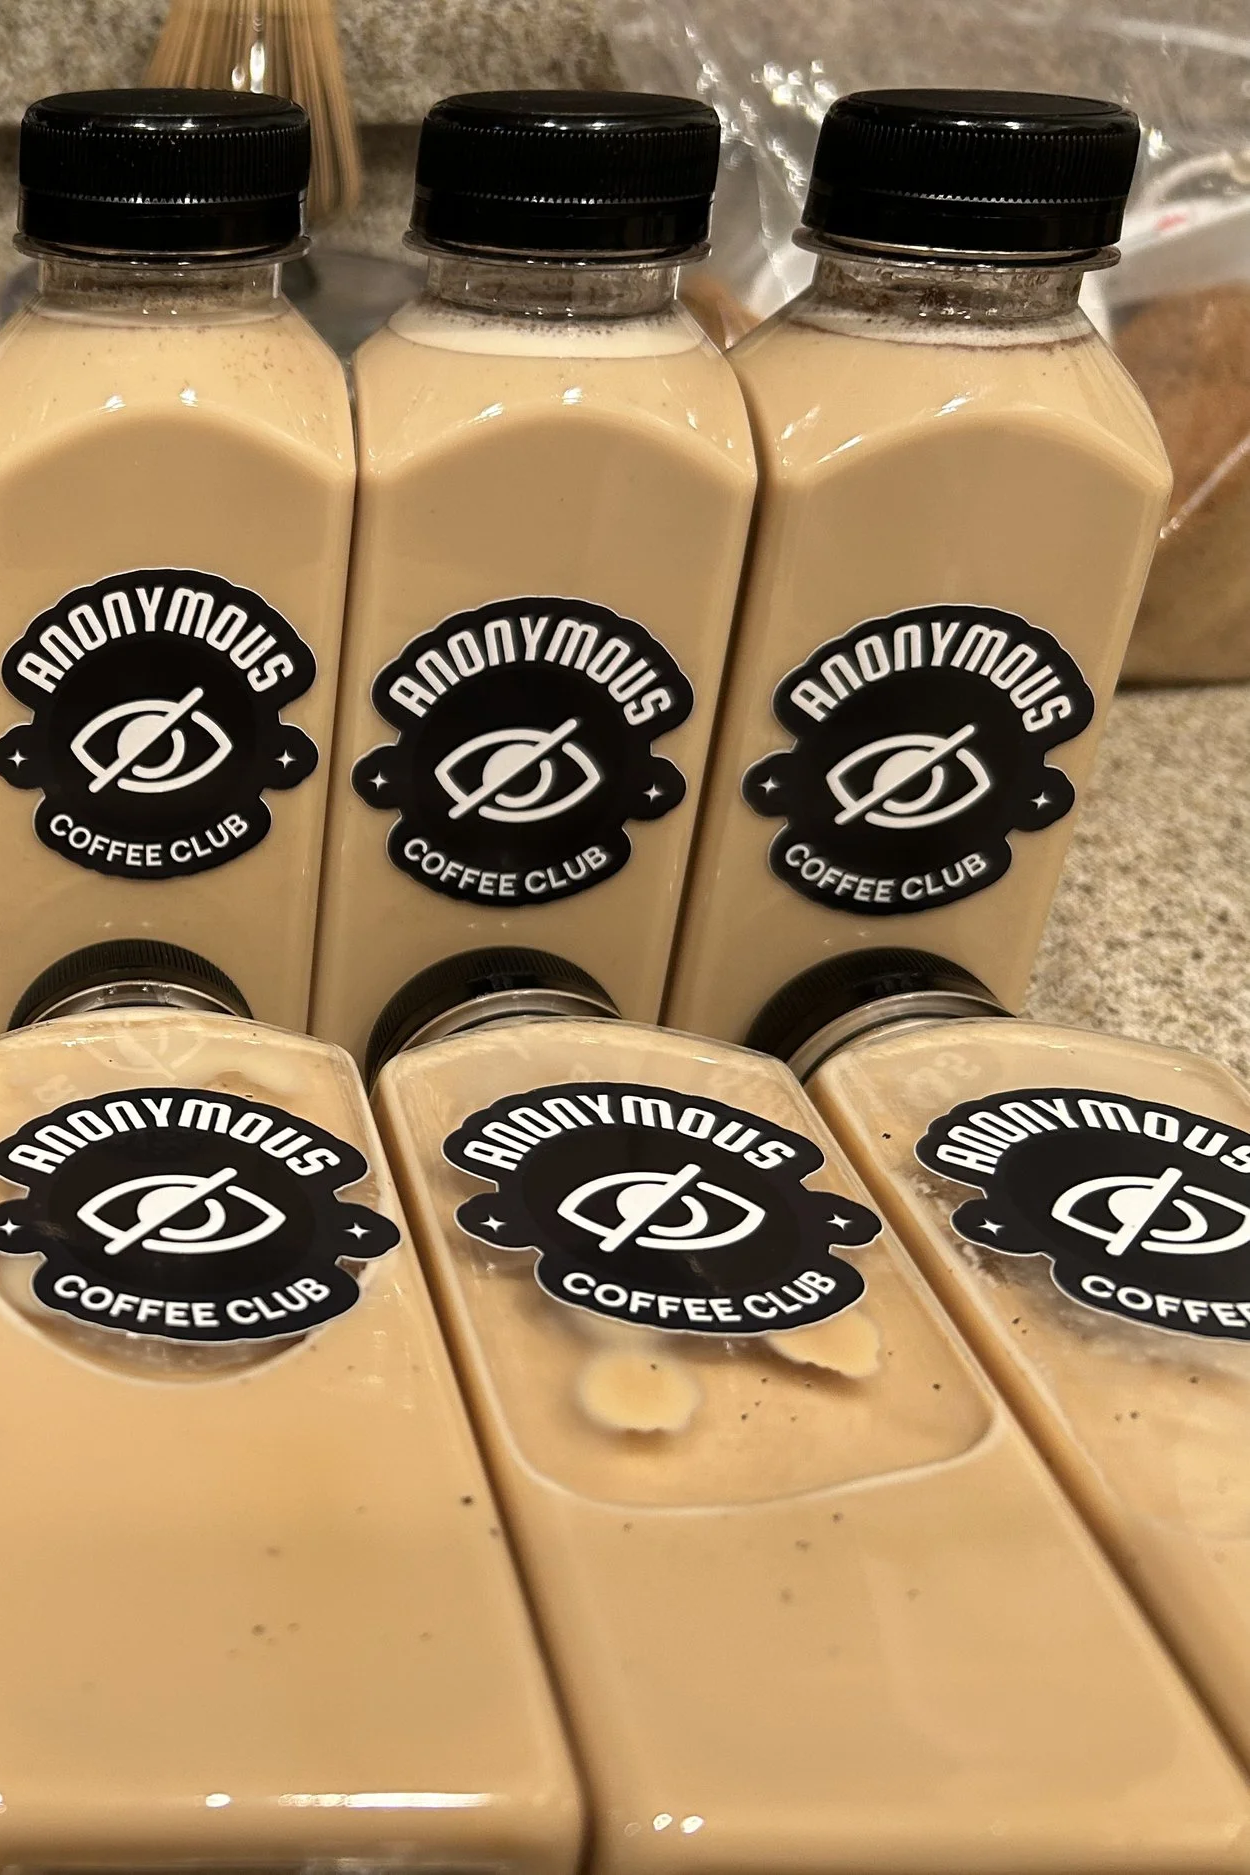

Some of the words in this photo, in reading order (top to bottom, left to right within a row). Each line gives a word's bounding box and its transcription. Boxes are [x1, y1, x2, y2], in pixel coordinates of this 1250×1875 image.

[16, 586, 294, 694] ANONYMOUS
[389, 616, 672, 726] ANONYMOUS
[790, 622, 1072, 733] ANONYMOUS
[49, 814, 162, 867] COFFEE
[169, 814, 249, 863] CLUB
[404, 838, 517, 896] COFFEE
[524, 846, 607, 893] CLUB
[785, 844, 894, 903] COFFEE
[901, 853, 987, 900] CLUB
[8, 1097, 341, 1176] ANONYMOUS
[463, 1094, 796, 1171] ANONYMOUS
[53, 1274, 220, 1328] COFFEE
[226, 1277, 330, 1325] CLUB
[562, 1272, 742, 1322] COFFEE
[743, 1271, 837, 1319] CLUB
